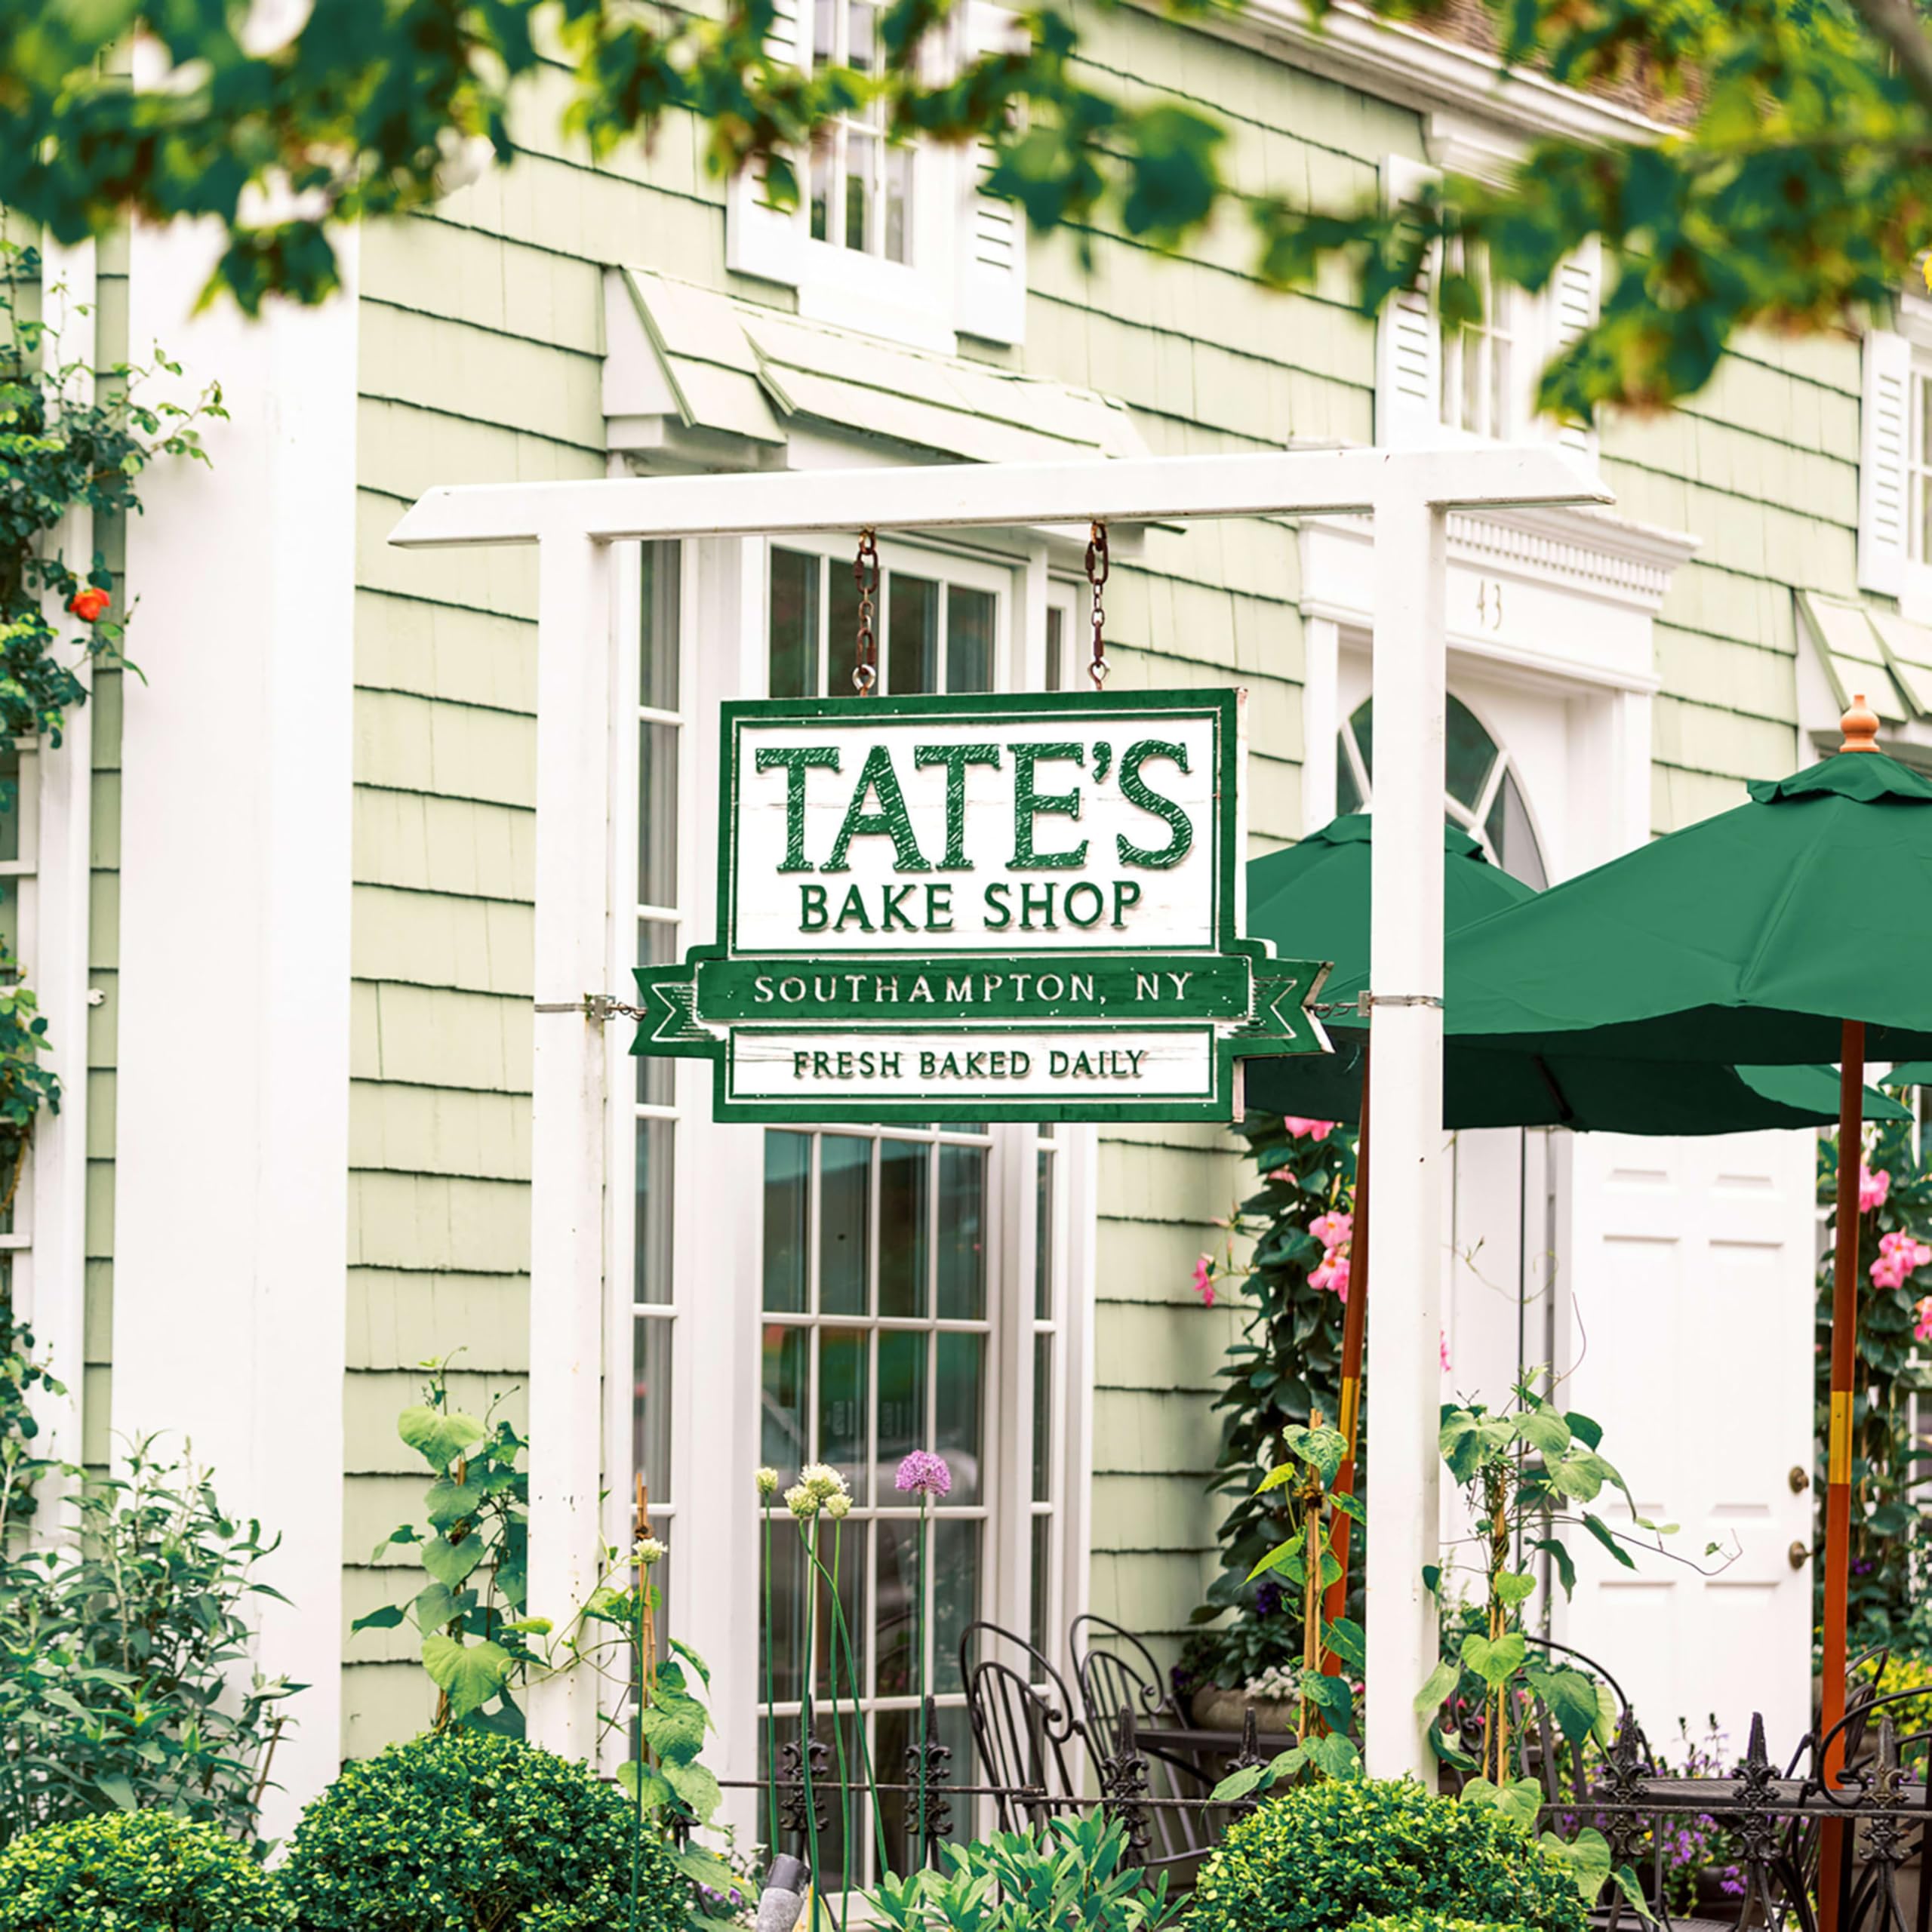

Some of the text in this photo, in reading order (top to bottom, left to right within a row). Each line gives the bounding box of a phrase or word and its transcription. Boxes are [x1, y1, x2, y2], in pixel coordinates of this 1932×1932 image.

[1477, 579, 1503, 630] 43
[755, 739, 1193, 872] TATE'S
[798, 881, 1141, 932] BAKE SHOP
[754, 971, 1194, 1004] SOUTHAMPTON, NY
[792, 1048, 1146, 1078] FRESH BAKED DAILY
